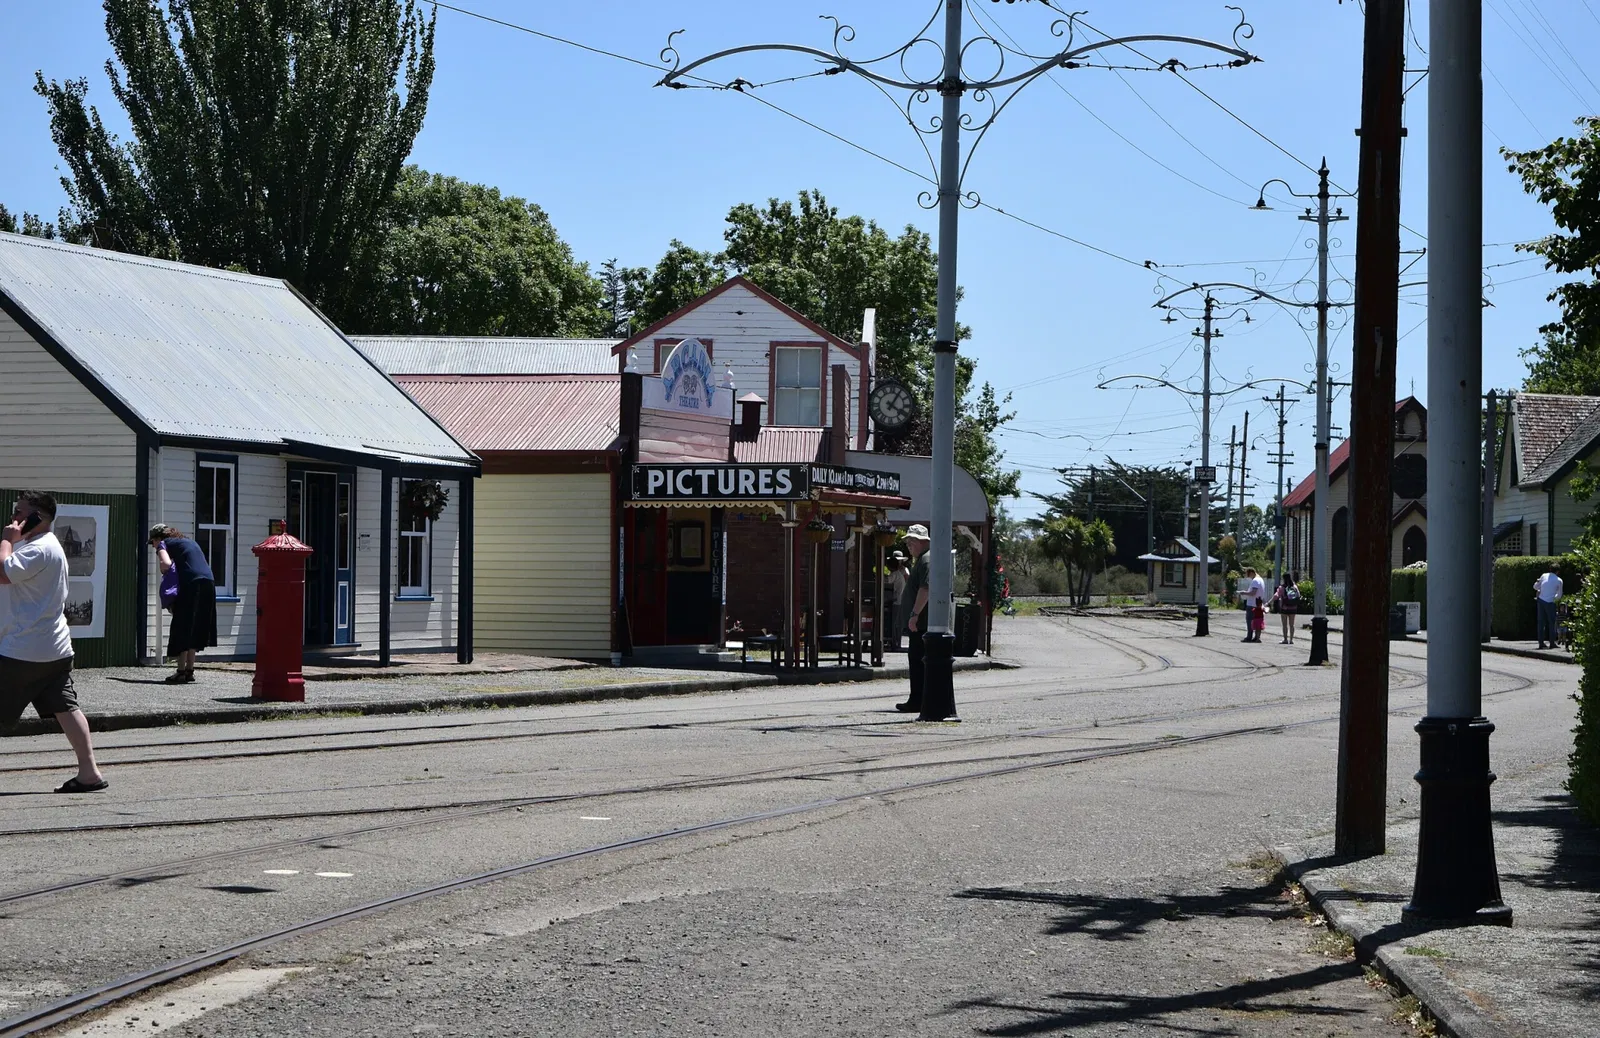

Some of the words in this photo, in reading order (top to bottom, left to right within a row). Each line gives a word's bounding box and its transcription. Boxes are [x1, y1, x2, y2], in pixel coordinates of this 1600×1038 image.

[679, 395, 699, 409] THEATRE
[647, 468, 793, 495] PICTURES
[812, 466, 828, 483] DAILY
[712, 531, 720, 593] PICTURE
